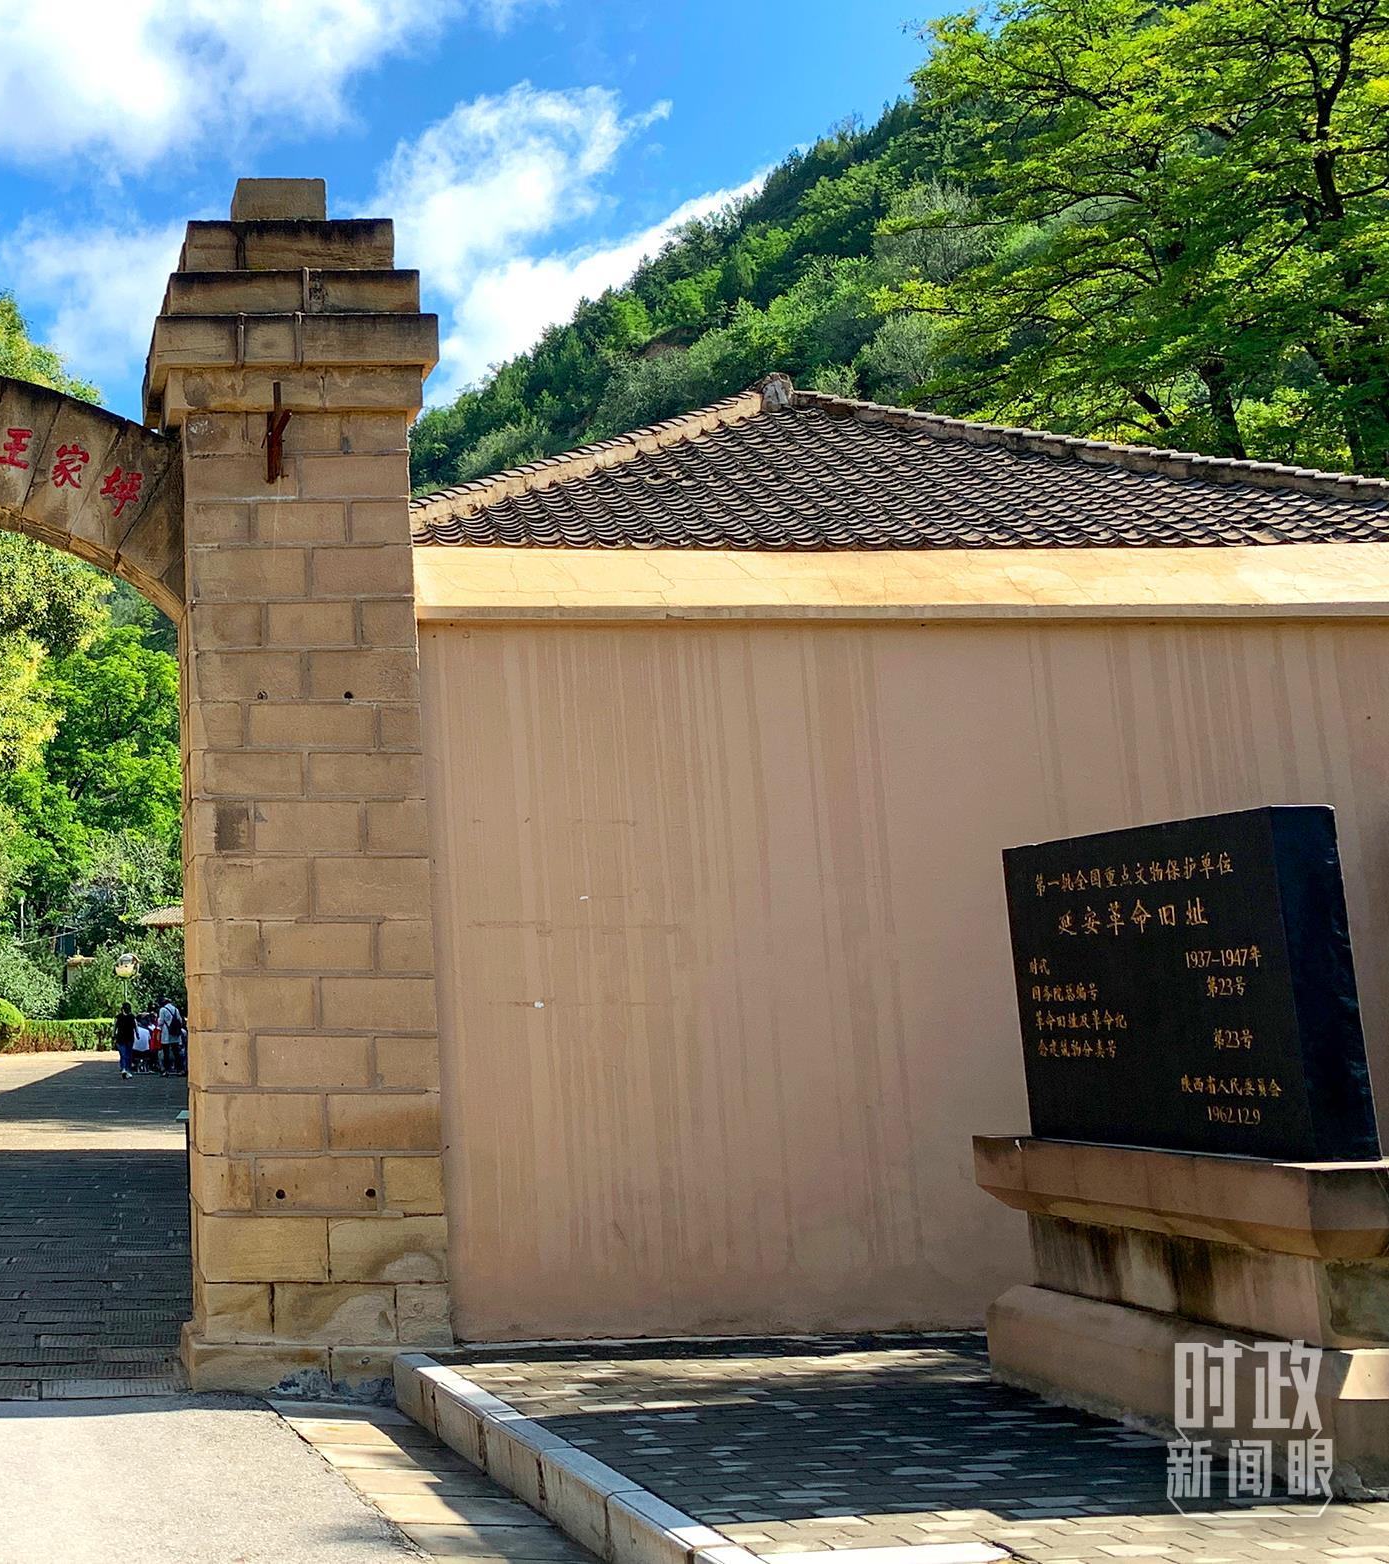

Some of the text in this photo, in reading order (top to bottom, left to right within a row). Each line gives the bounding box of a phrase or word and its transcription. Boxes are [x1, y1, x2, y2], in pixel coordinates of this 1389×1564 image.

[1035, 851, 1234, 897] 第一批全国重点文物保护单位
[1058, 897, 1208, 936] 延安革命旧址
[1206, 975, 1246, 998] 第23号
[1213, 1028, 1253, 1050] 第23号
[1180, 1074, 1283, 1097] 陕西省人民委员会
